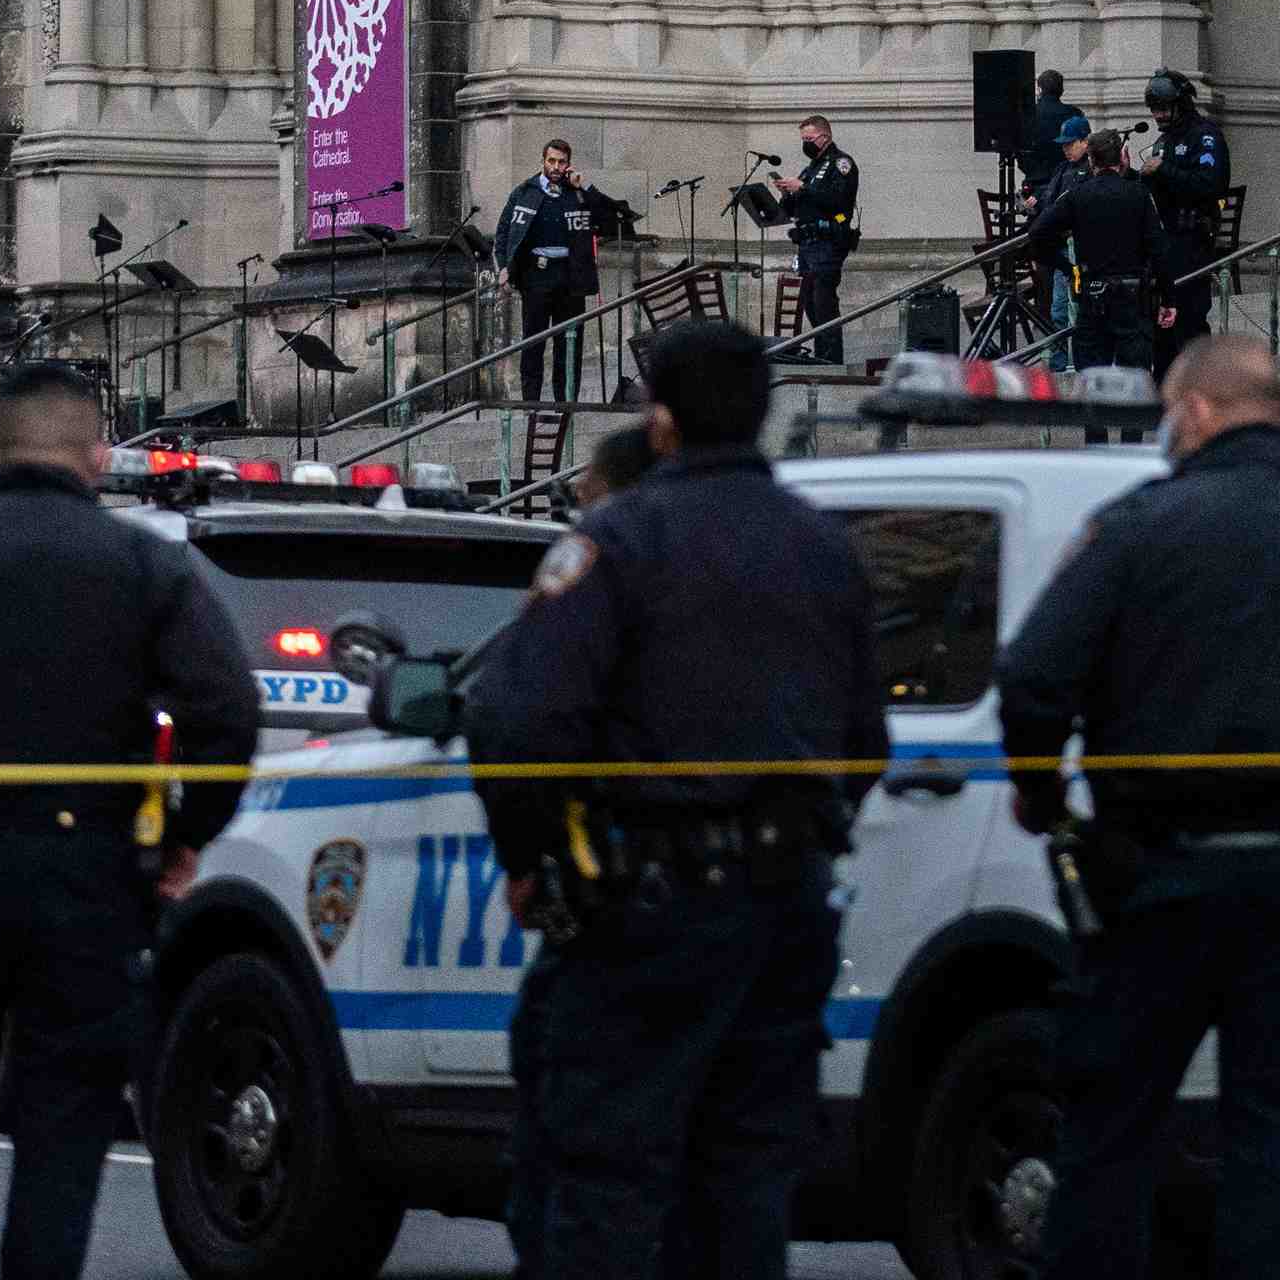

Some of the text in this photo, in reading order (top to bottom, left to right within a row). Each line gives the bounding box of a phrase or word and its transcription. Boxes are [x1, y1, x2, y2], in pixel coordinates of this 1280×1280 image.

[312, 127, 349, 148] Enter the
[312, 146, 352, 169] Cathedral.
[263, 676, 349, 705] YPD
